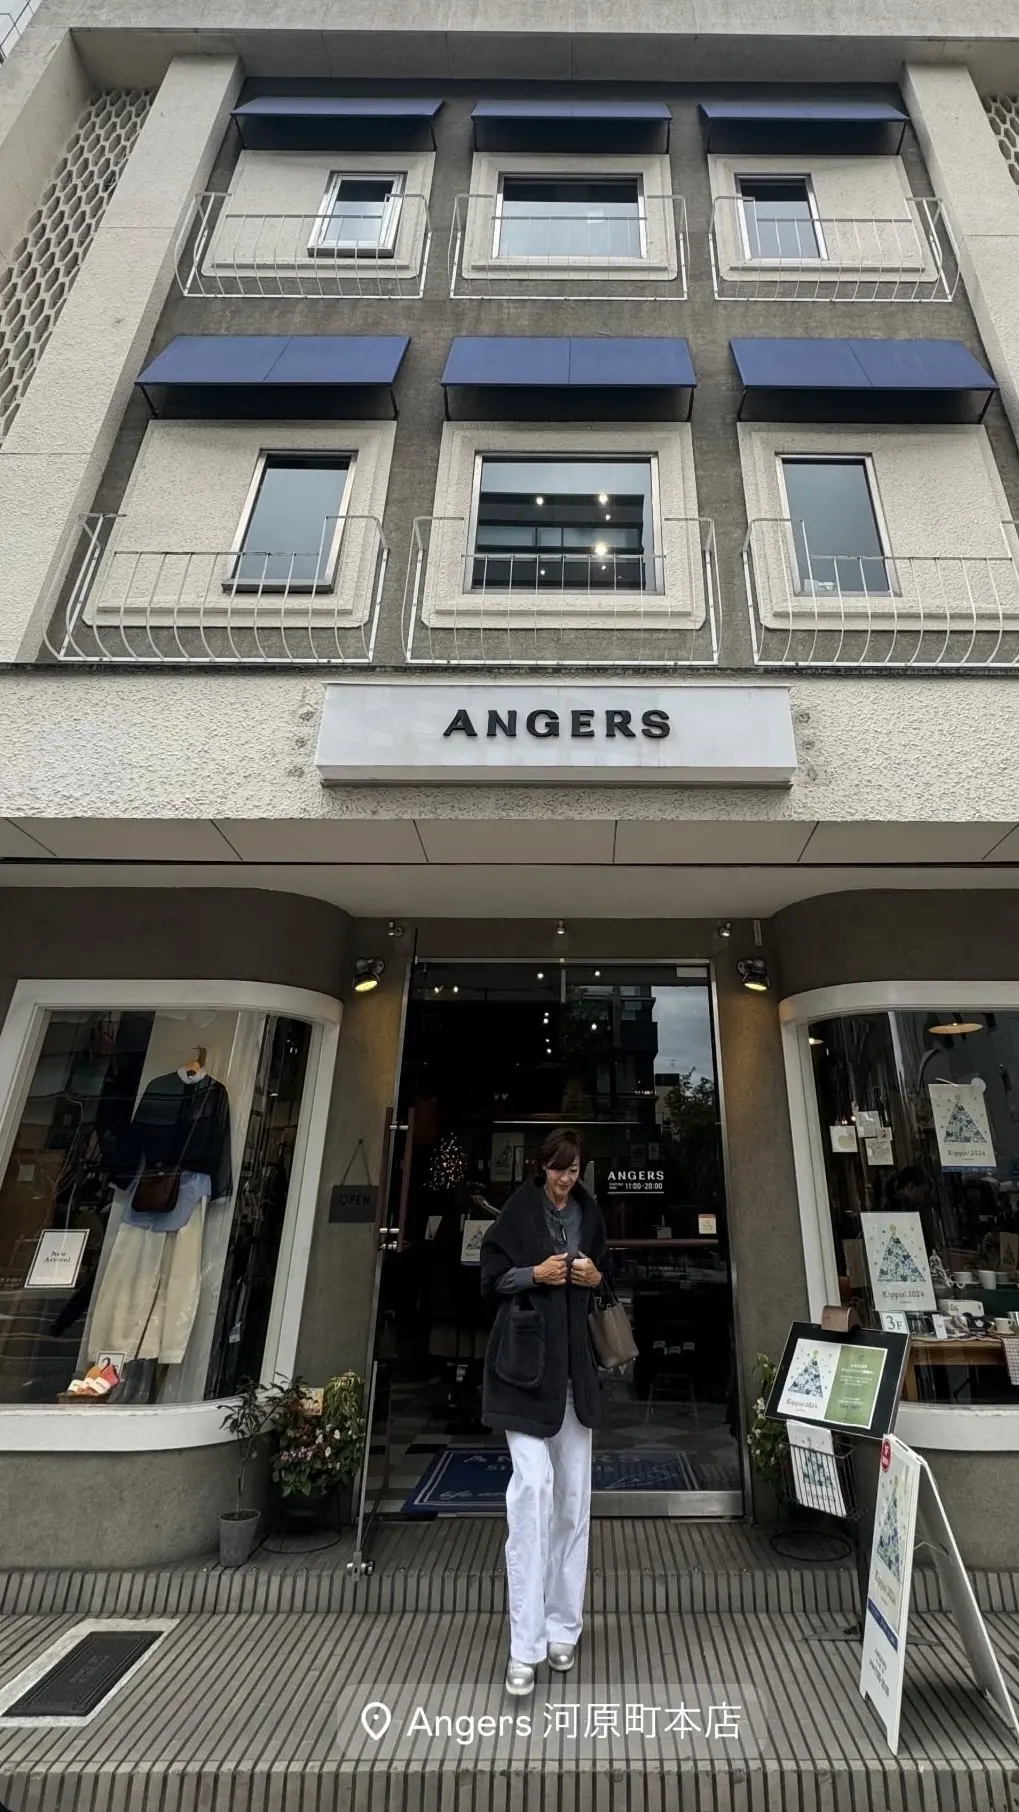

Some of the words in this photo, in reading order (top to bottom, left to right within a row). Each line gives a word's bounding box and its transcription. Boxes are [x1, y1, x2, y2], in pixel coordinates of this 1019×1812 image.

[443, 709, 671, 739] ANGERS
[607, 1170, 665, 1181] ANGERS
[339, 1194, 371, 1205] OPEN
[907, 1290, 925, 1299] 2024
[885, 1315, 903, 1331] 3F
